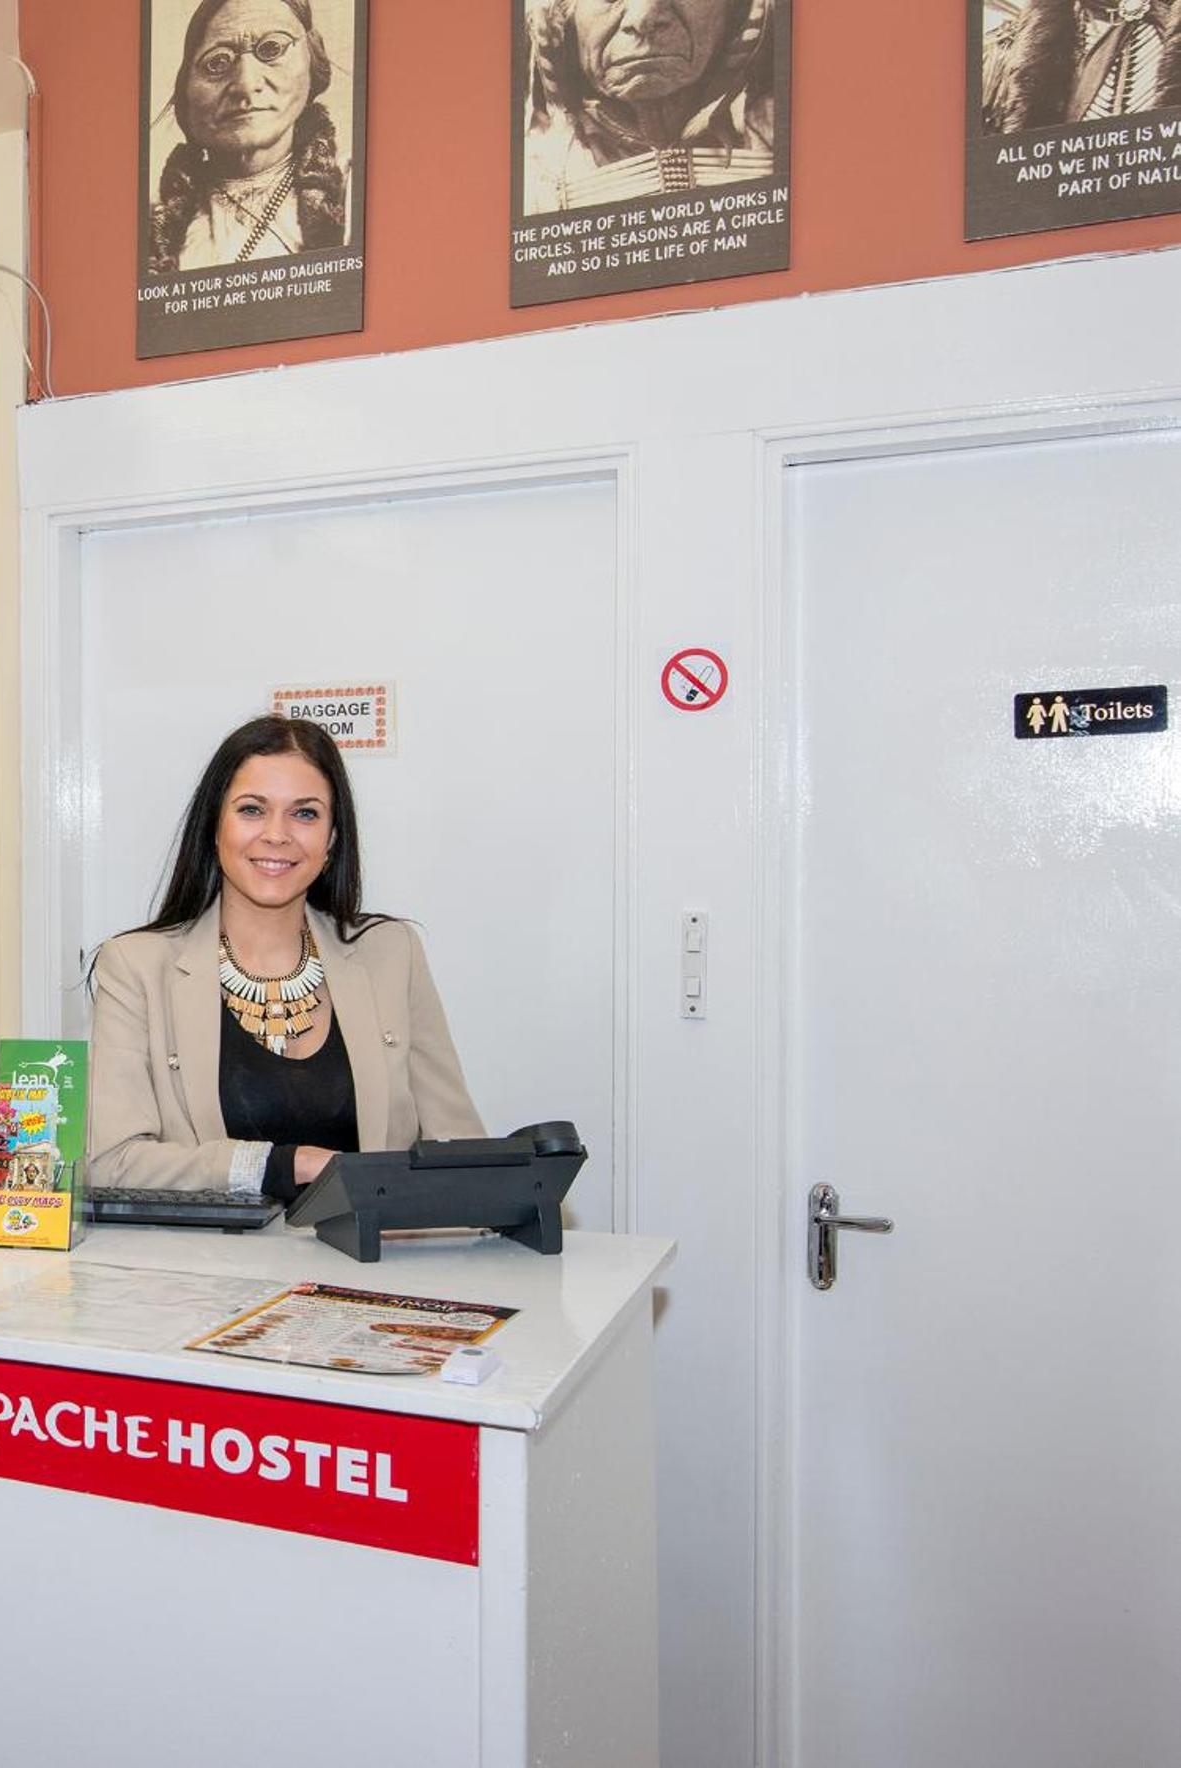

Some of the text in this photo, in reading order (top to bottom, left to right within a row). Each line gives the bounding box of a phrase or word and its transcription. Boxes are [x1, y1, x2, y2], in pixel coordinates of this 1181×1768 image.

[997, 147, 1027, 164] ALL
[1033, 141, 1056, 159] OF
[1061, 130, 1129, 153] NATURE
[1136, 126, 1153, 143] IS
[1017, 163, 1053, 183] AND
[1058, 158, 1085, 175] WE
[1092, 154, 1110, 171] IN
[1116, 146, 1166, 168] TURN,
[1058, 177, 1102, 197] PART
[1108, 172, 1132, 190] OF
[512, 187, 788, 245] THE POWER OF THE WORLD WORKS IN
[514, 208, 786, 263] CIRCLES. THE SEASONS ARE A CIRCLE
[547, 233, 748, 277] AND SO IS THE LIFE OF MAN
[138, 256, 363, 302] LOOK AT YOUR SONS AND DAUGHTERS
[165, 279, 332, 314] FOR THEY ARE YOUR FUTURE
[291, 702, 370, 719] BAGGAGE
[319, 722, 354, 735] OOM
[1080, 701, 1154, 722] Toilets
[166, 1419, 409, 1503] HOSTEL
